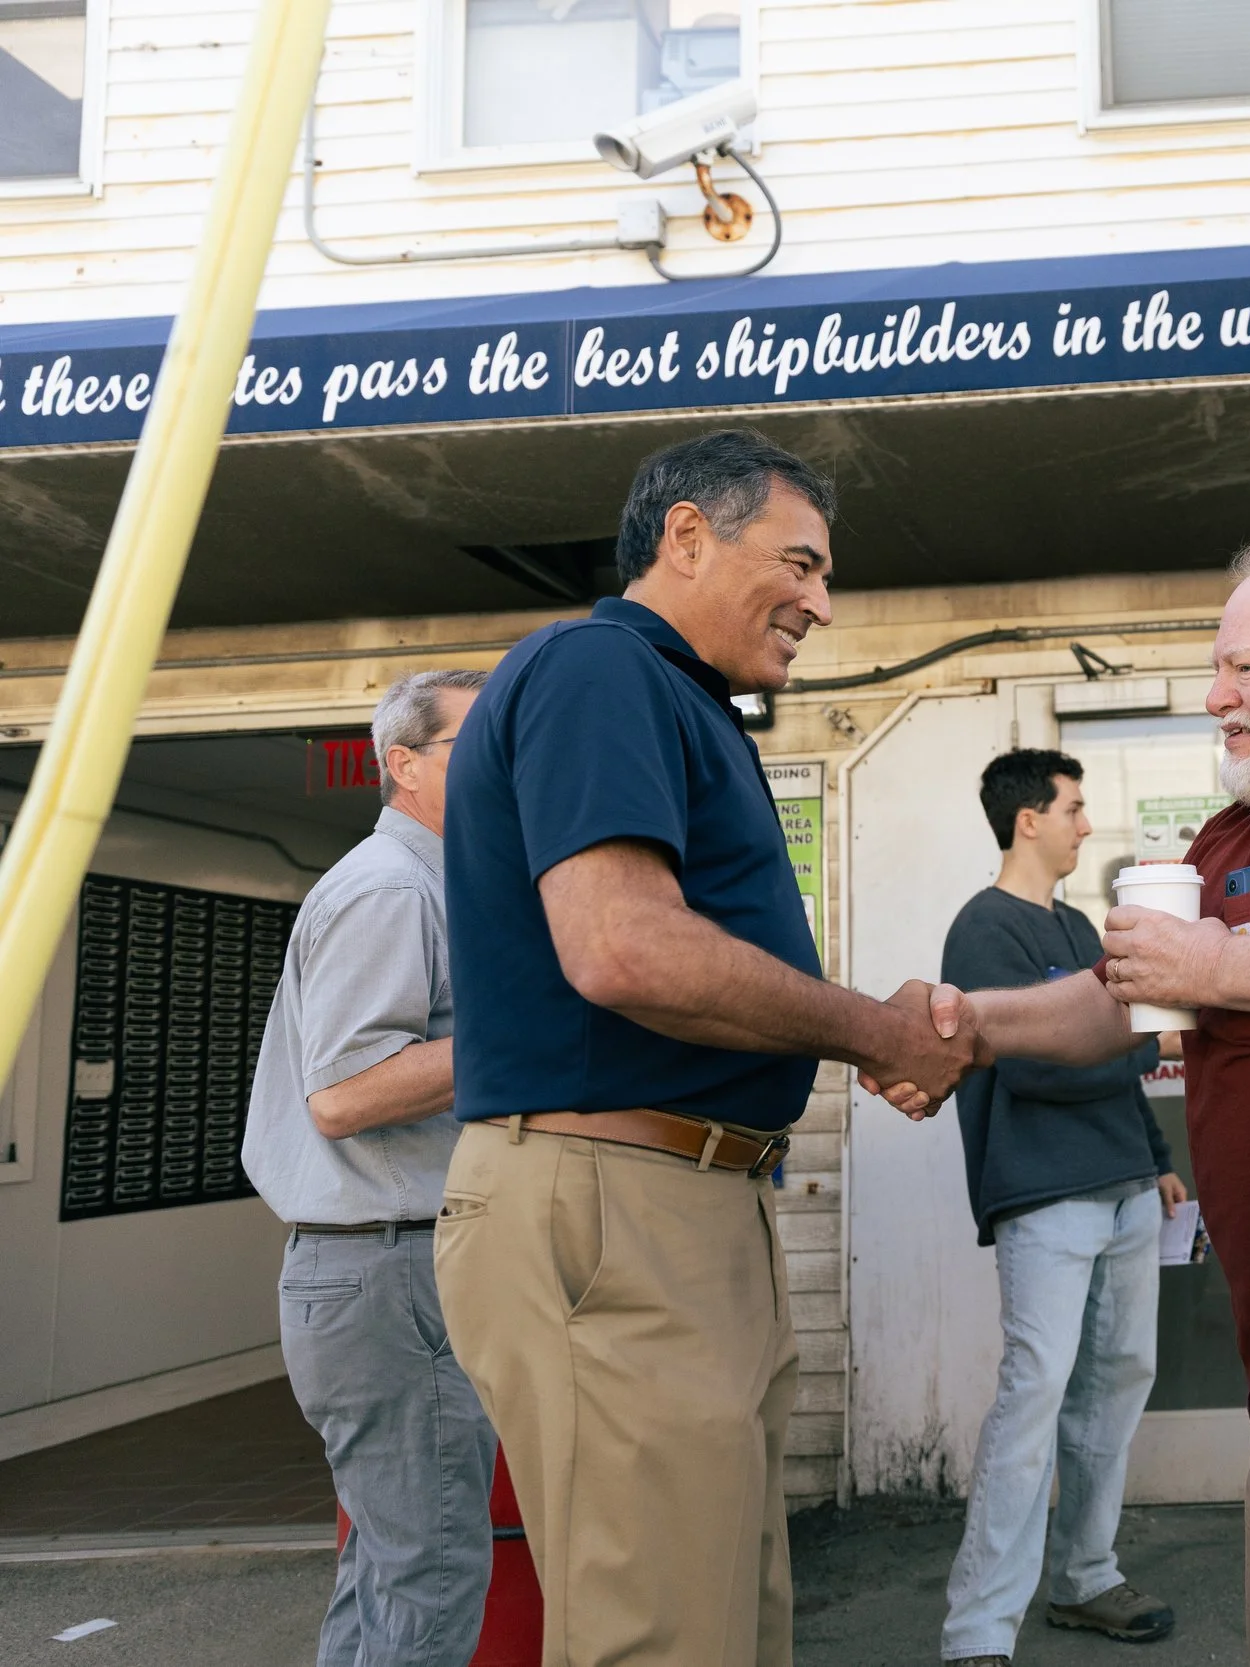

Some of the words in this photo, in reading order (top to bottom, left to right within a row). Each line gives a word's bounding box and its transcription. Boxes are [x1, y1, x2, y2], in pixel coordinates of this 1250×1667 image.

[21, 355, 152, 417] these
[229, 354, 303, 407] tes
[322, 357, 448, 423] pass
[468, 331, 550, 395] the
[574, 326, 680, 388] best
[695, 301, 1032, 396] shipbuilders
[1053, 302, 1106, 357] in
[1122, 289, 1204, 353] the
